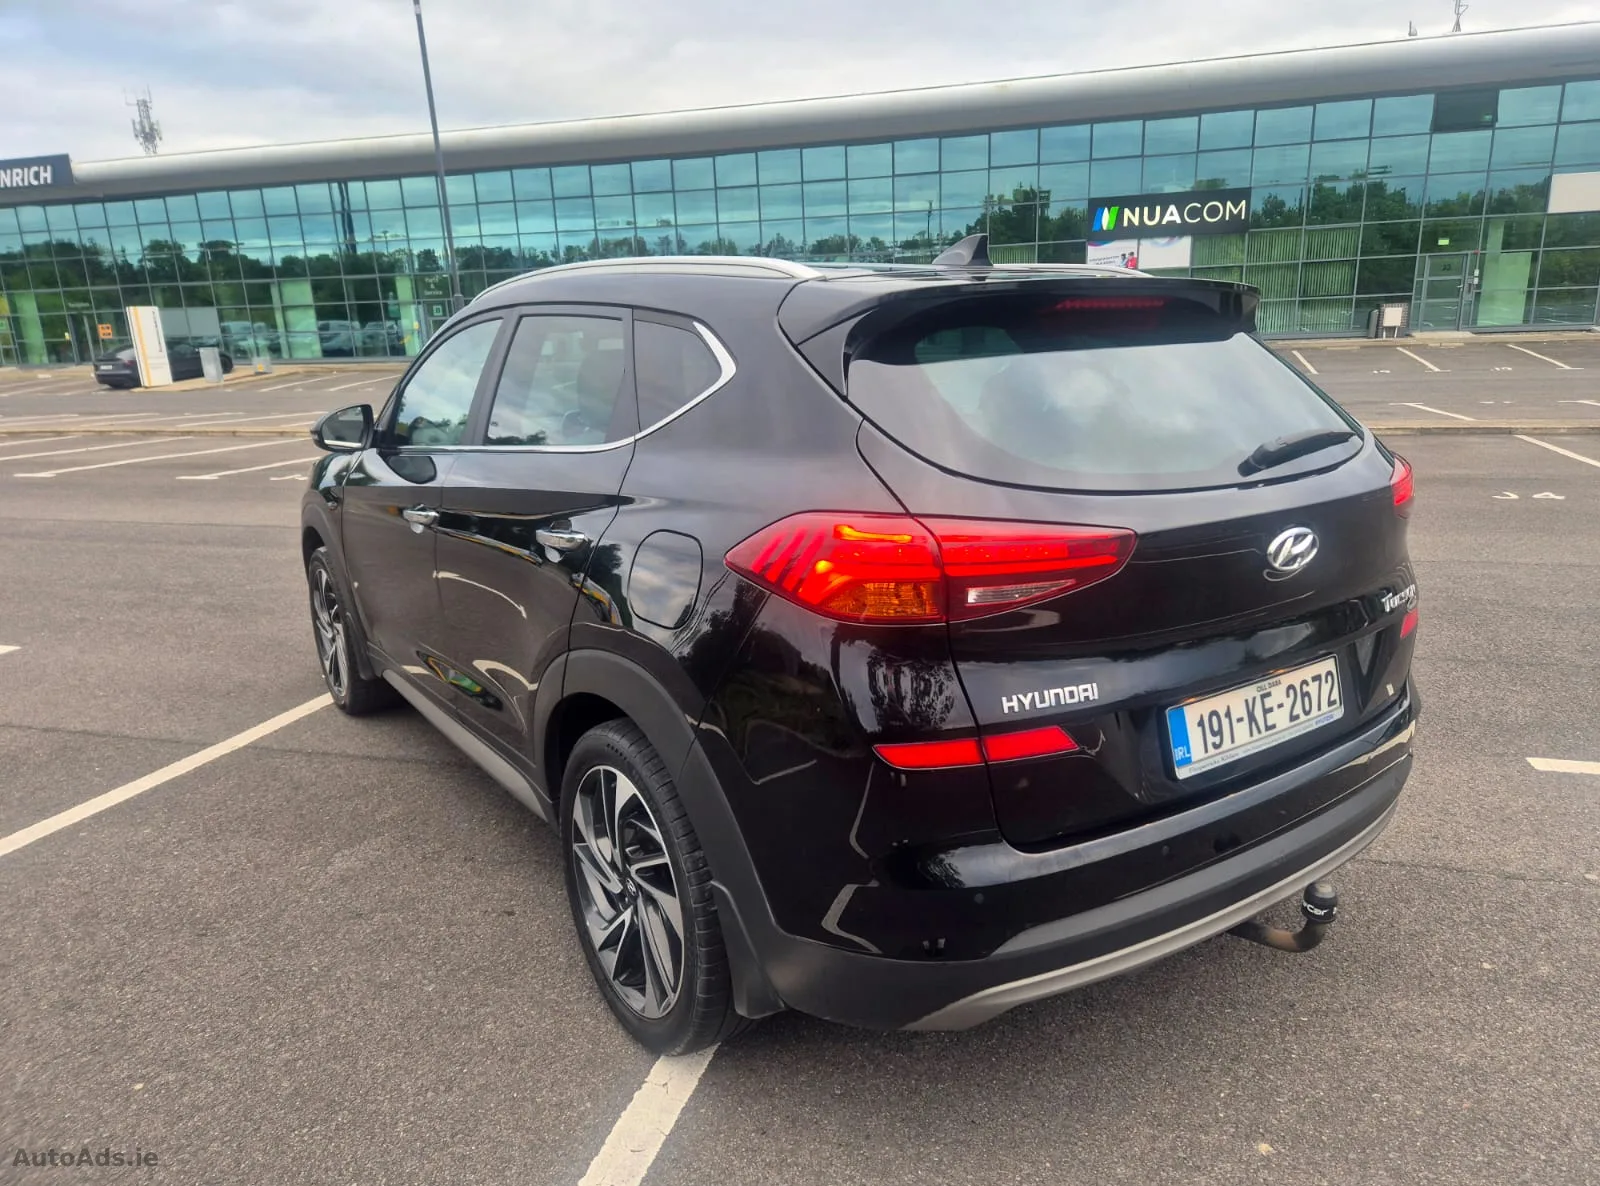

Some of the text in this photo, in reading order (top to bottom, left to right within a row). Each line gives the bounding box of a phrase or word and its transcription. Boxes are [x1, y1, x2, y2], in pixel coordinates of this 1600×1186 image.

[0, 165, 52, 188] NRICH
[1123, 200, 1246, 227] NUACOM
[1001, 682, 1099, 714] HYUNDAI
[1197, 670, 1338, 754] 191-KE-2672
[1174, 746, 1192, 761] IRL
